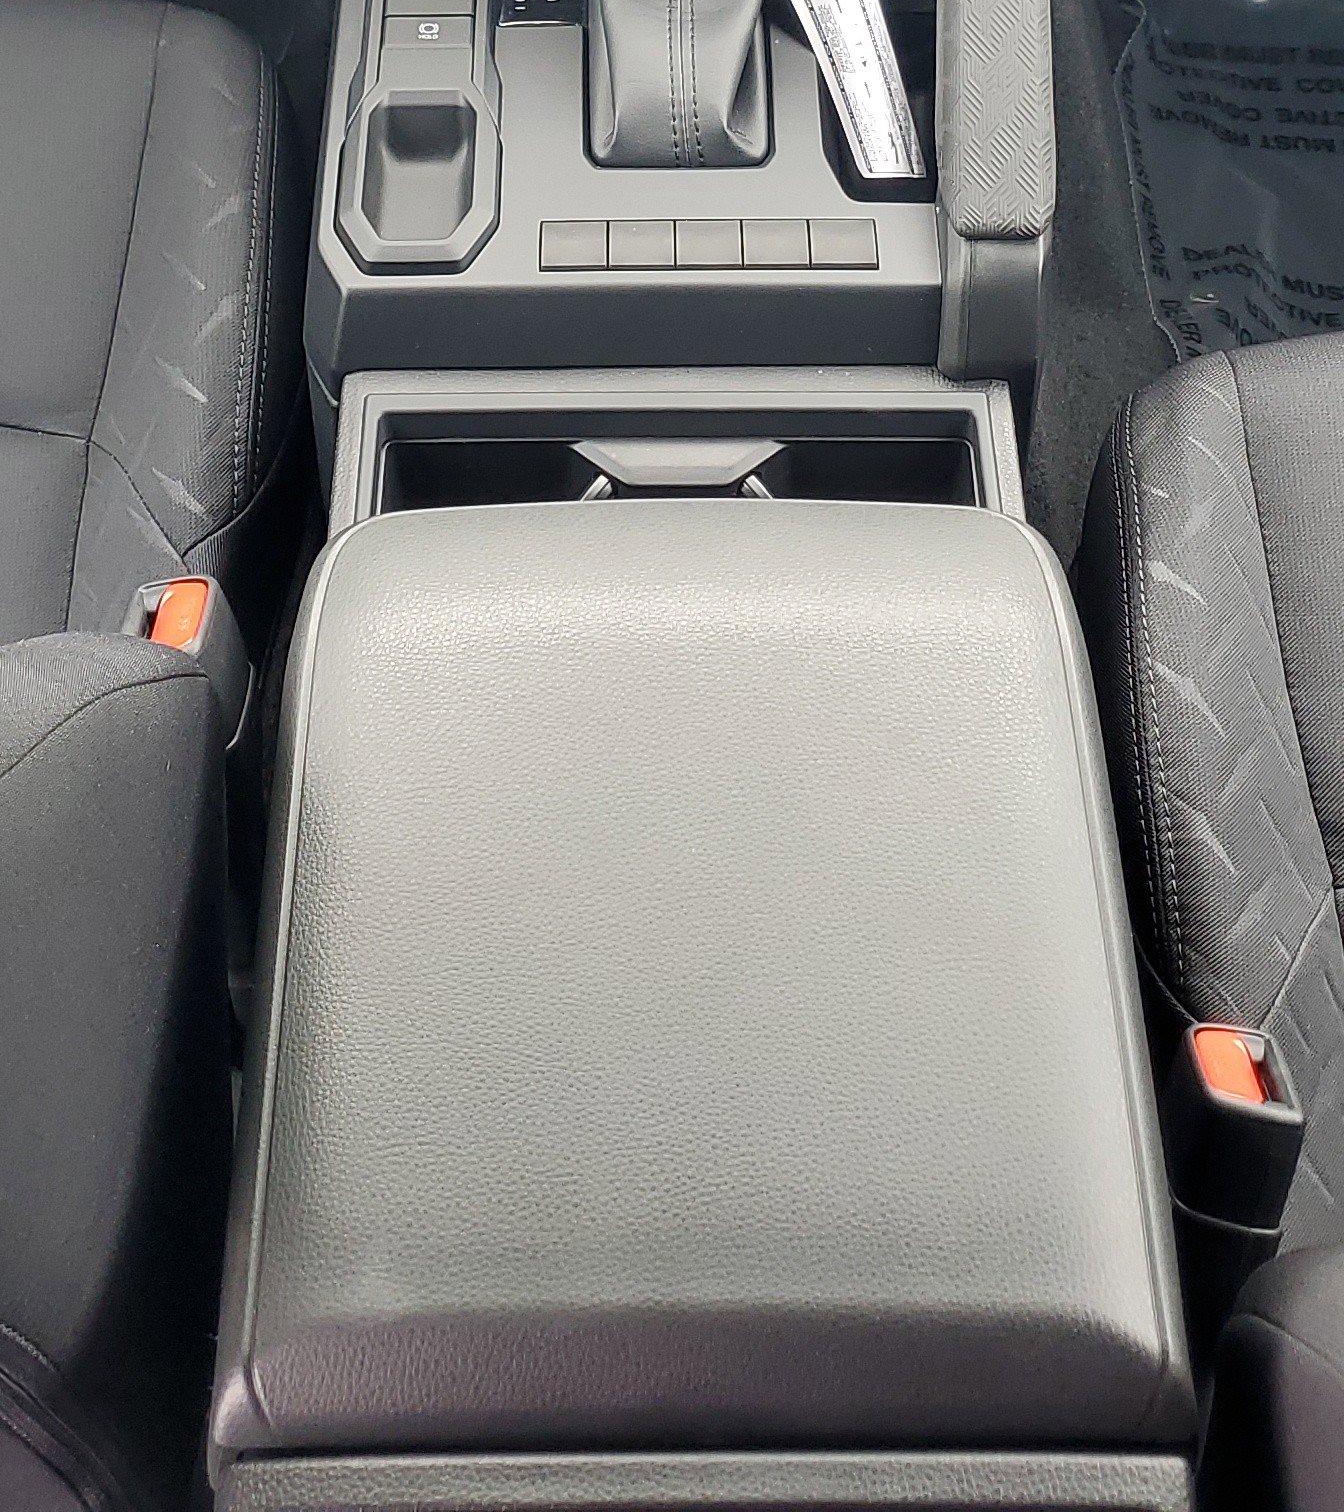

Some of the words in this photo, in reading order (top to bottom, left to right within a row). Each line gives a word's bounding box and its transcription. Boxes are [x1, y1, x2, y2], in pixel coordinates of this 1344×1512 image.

[1176, 90, 1262, 122] COVER
[1149, 103, 1251, 147] REMOVE
[1260, 136, 1336, 153] MUST
